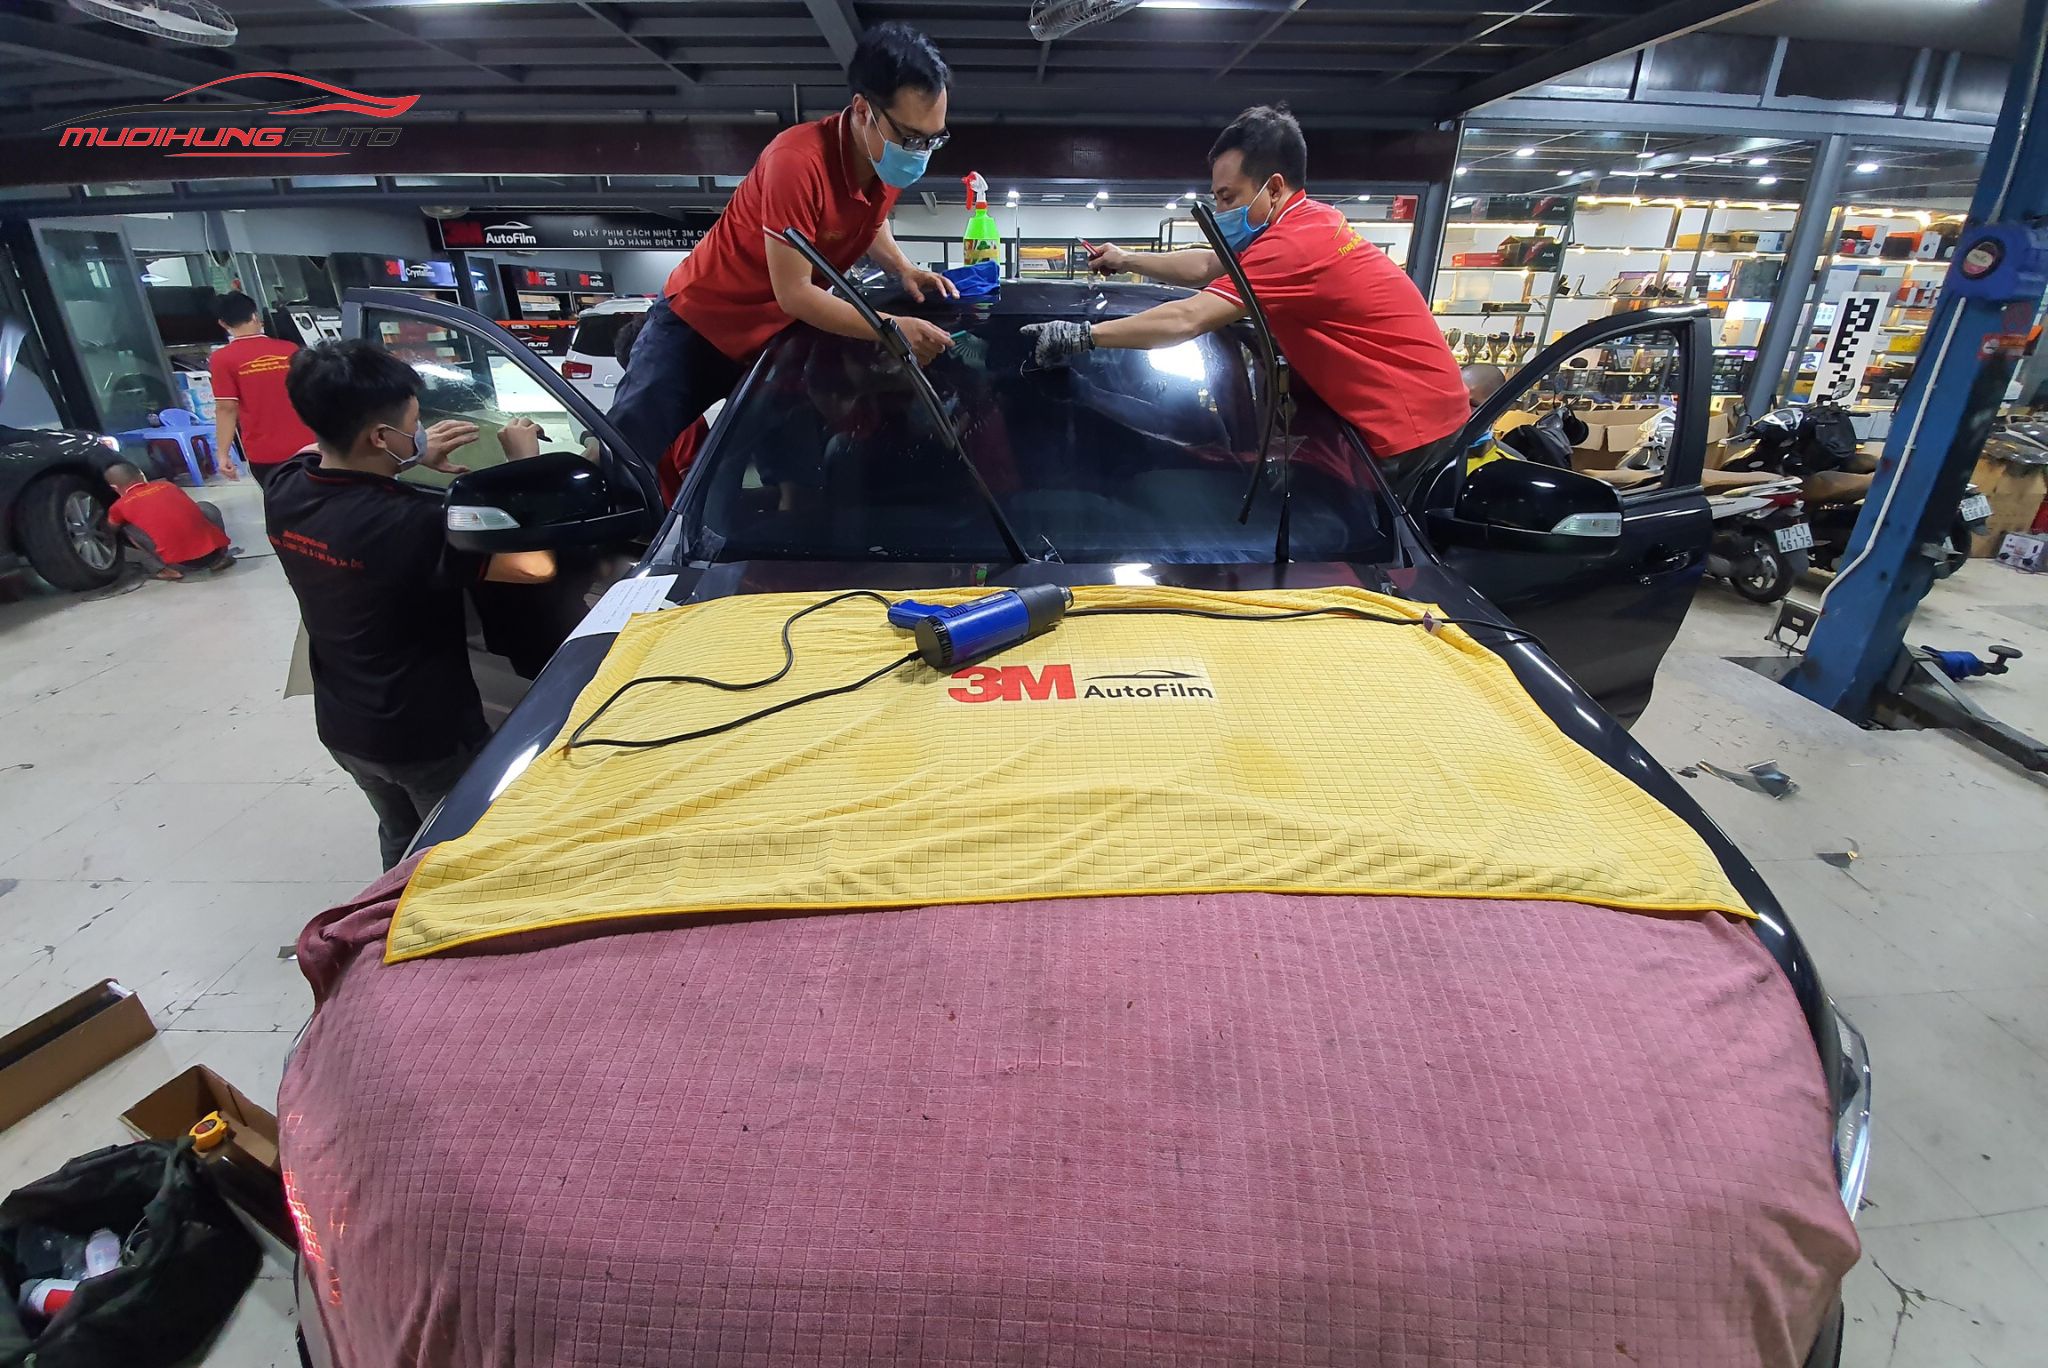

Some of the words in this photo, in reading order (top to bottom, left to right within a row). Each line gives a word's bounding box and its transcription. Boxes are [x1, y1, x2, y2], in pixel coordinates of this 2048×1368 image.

[486, 232, 537, 244] AutoFilm
[602, 229, 624, 237] PHIM
[682, 229, 694, 237] 3M
[948, 664, 1077, 704] 3M
[1084, 683, 1214, 699] AutoFilm
